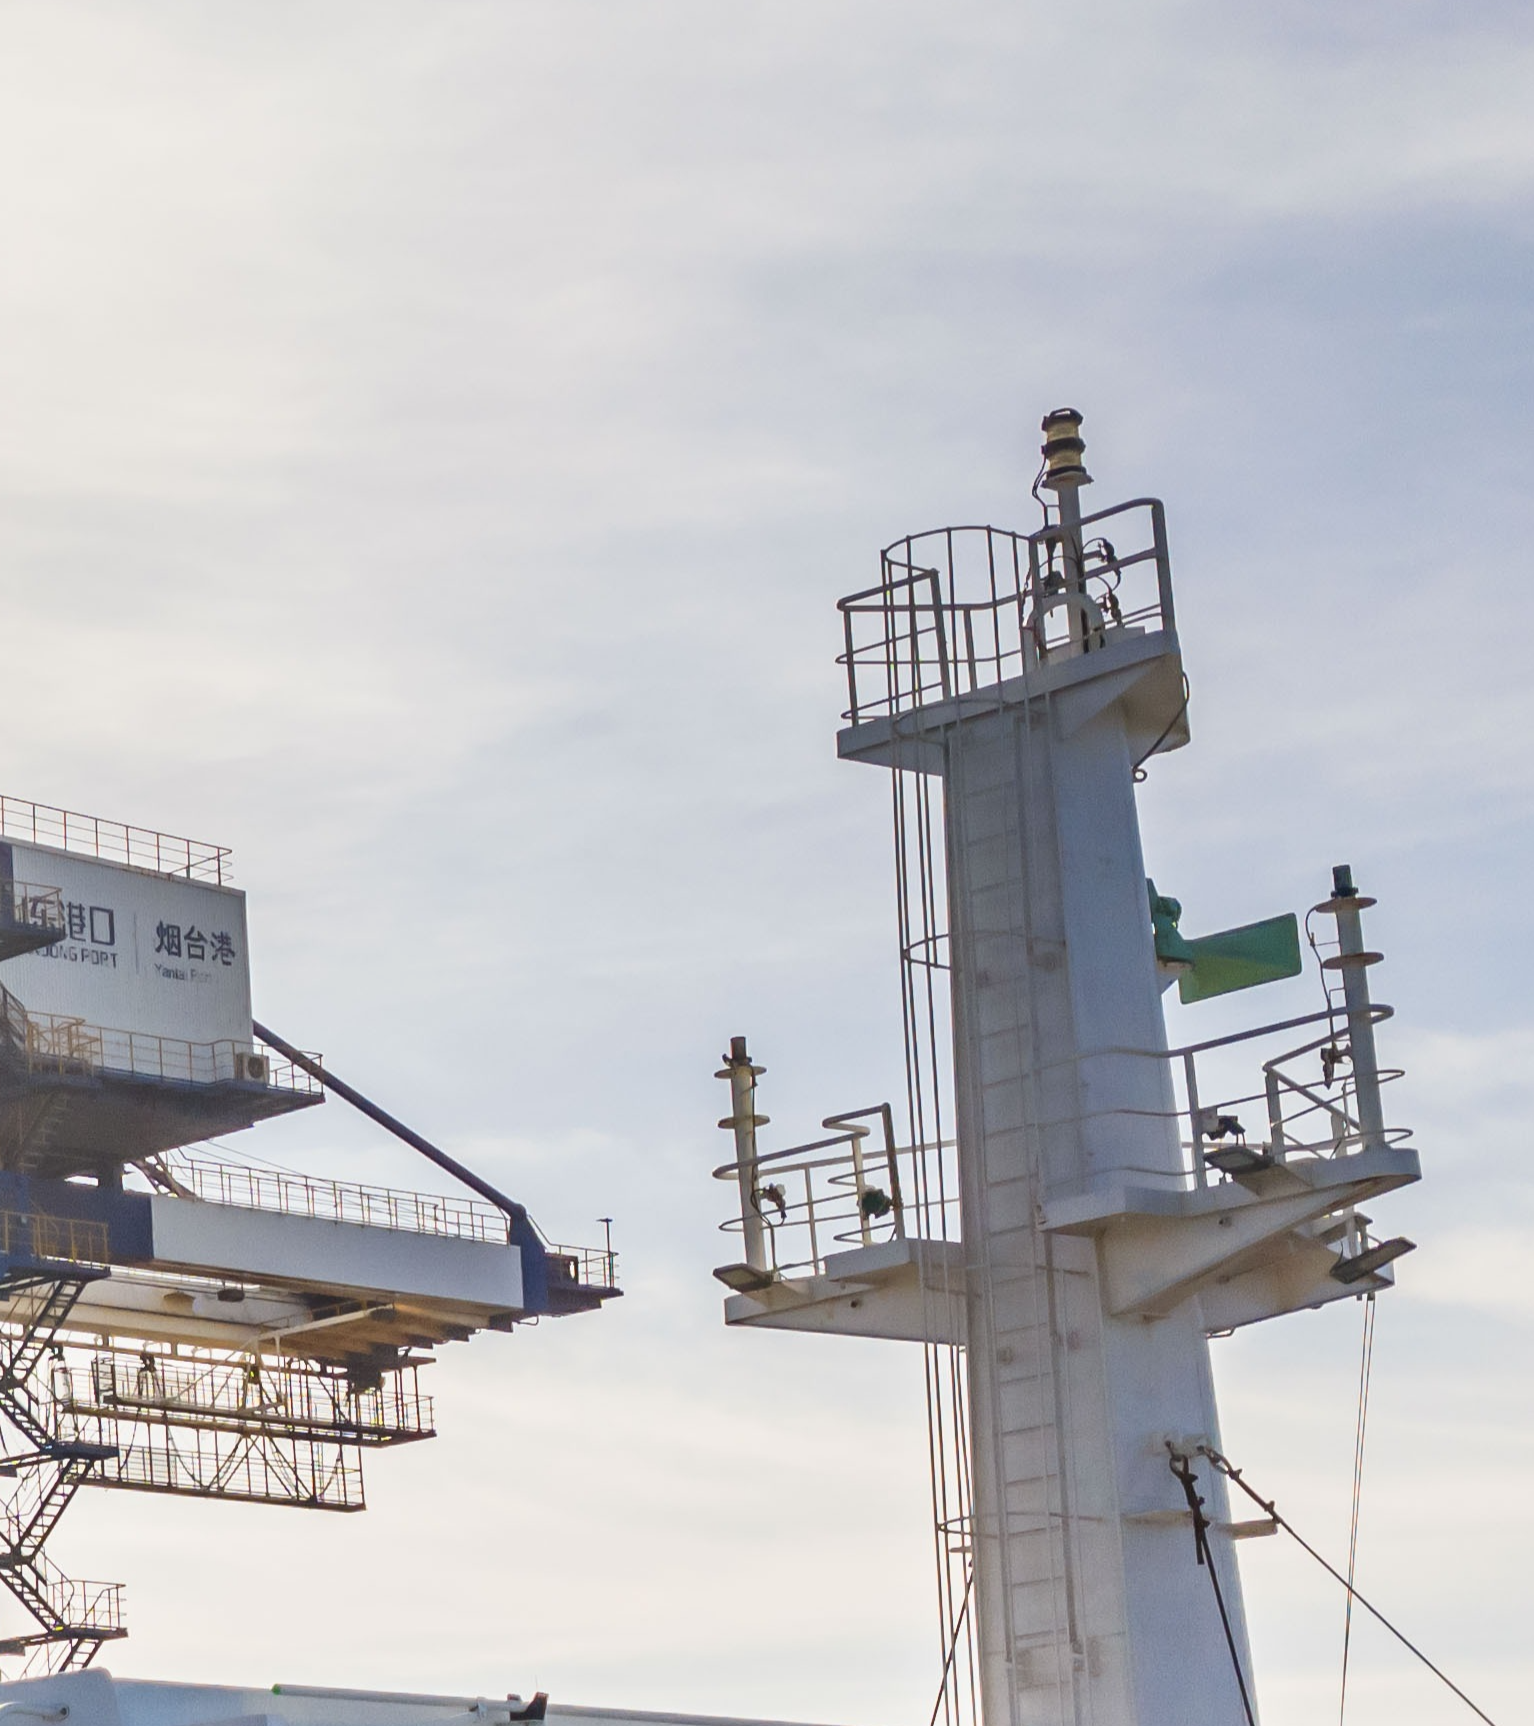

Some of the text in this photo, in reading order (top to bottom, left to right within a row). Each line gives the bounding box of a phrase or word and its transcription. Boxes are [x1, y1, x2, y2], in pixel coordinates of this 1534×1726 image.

[21, 896, 115, 946] 东港口
[155, 920, 236, 966] 烟台港
